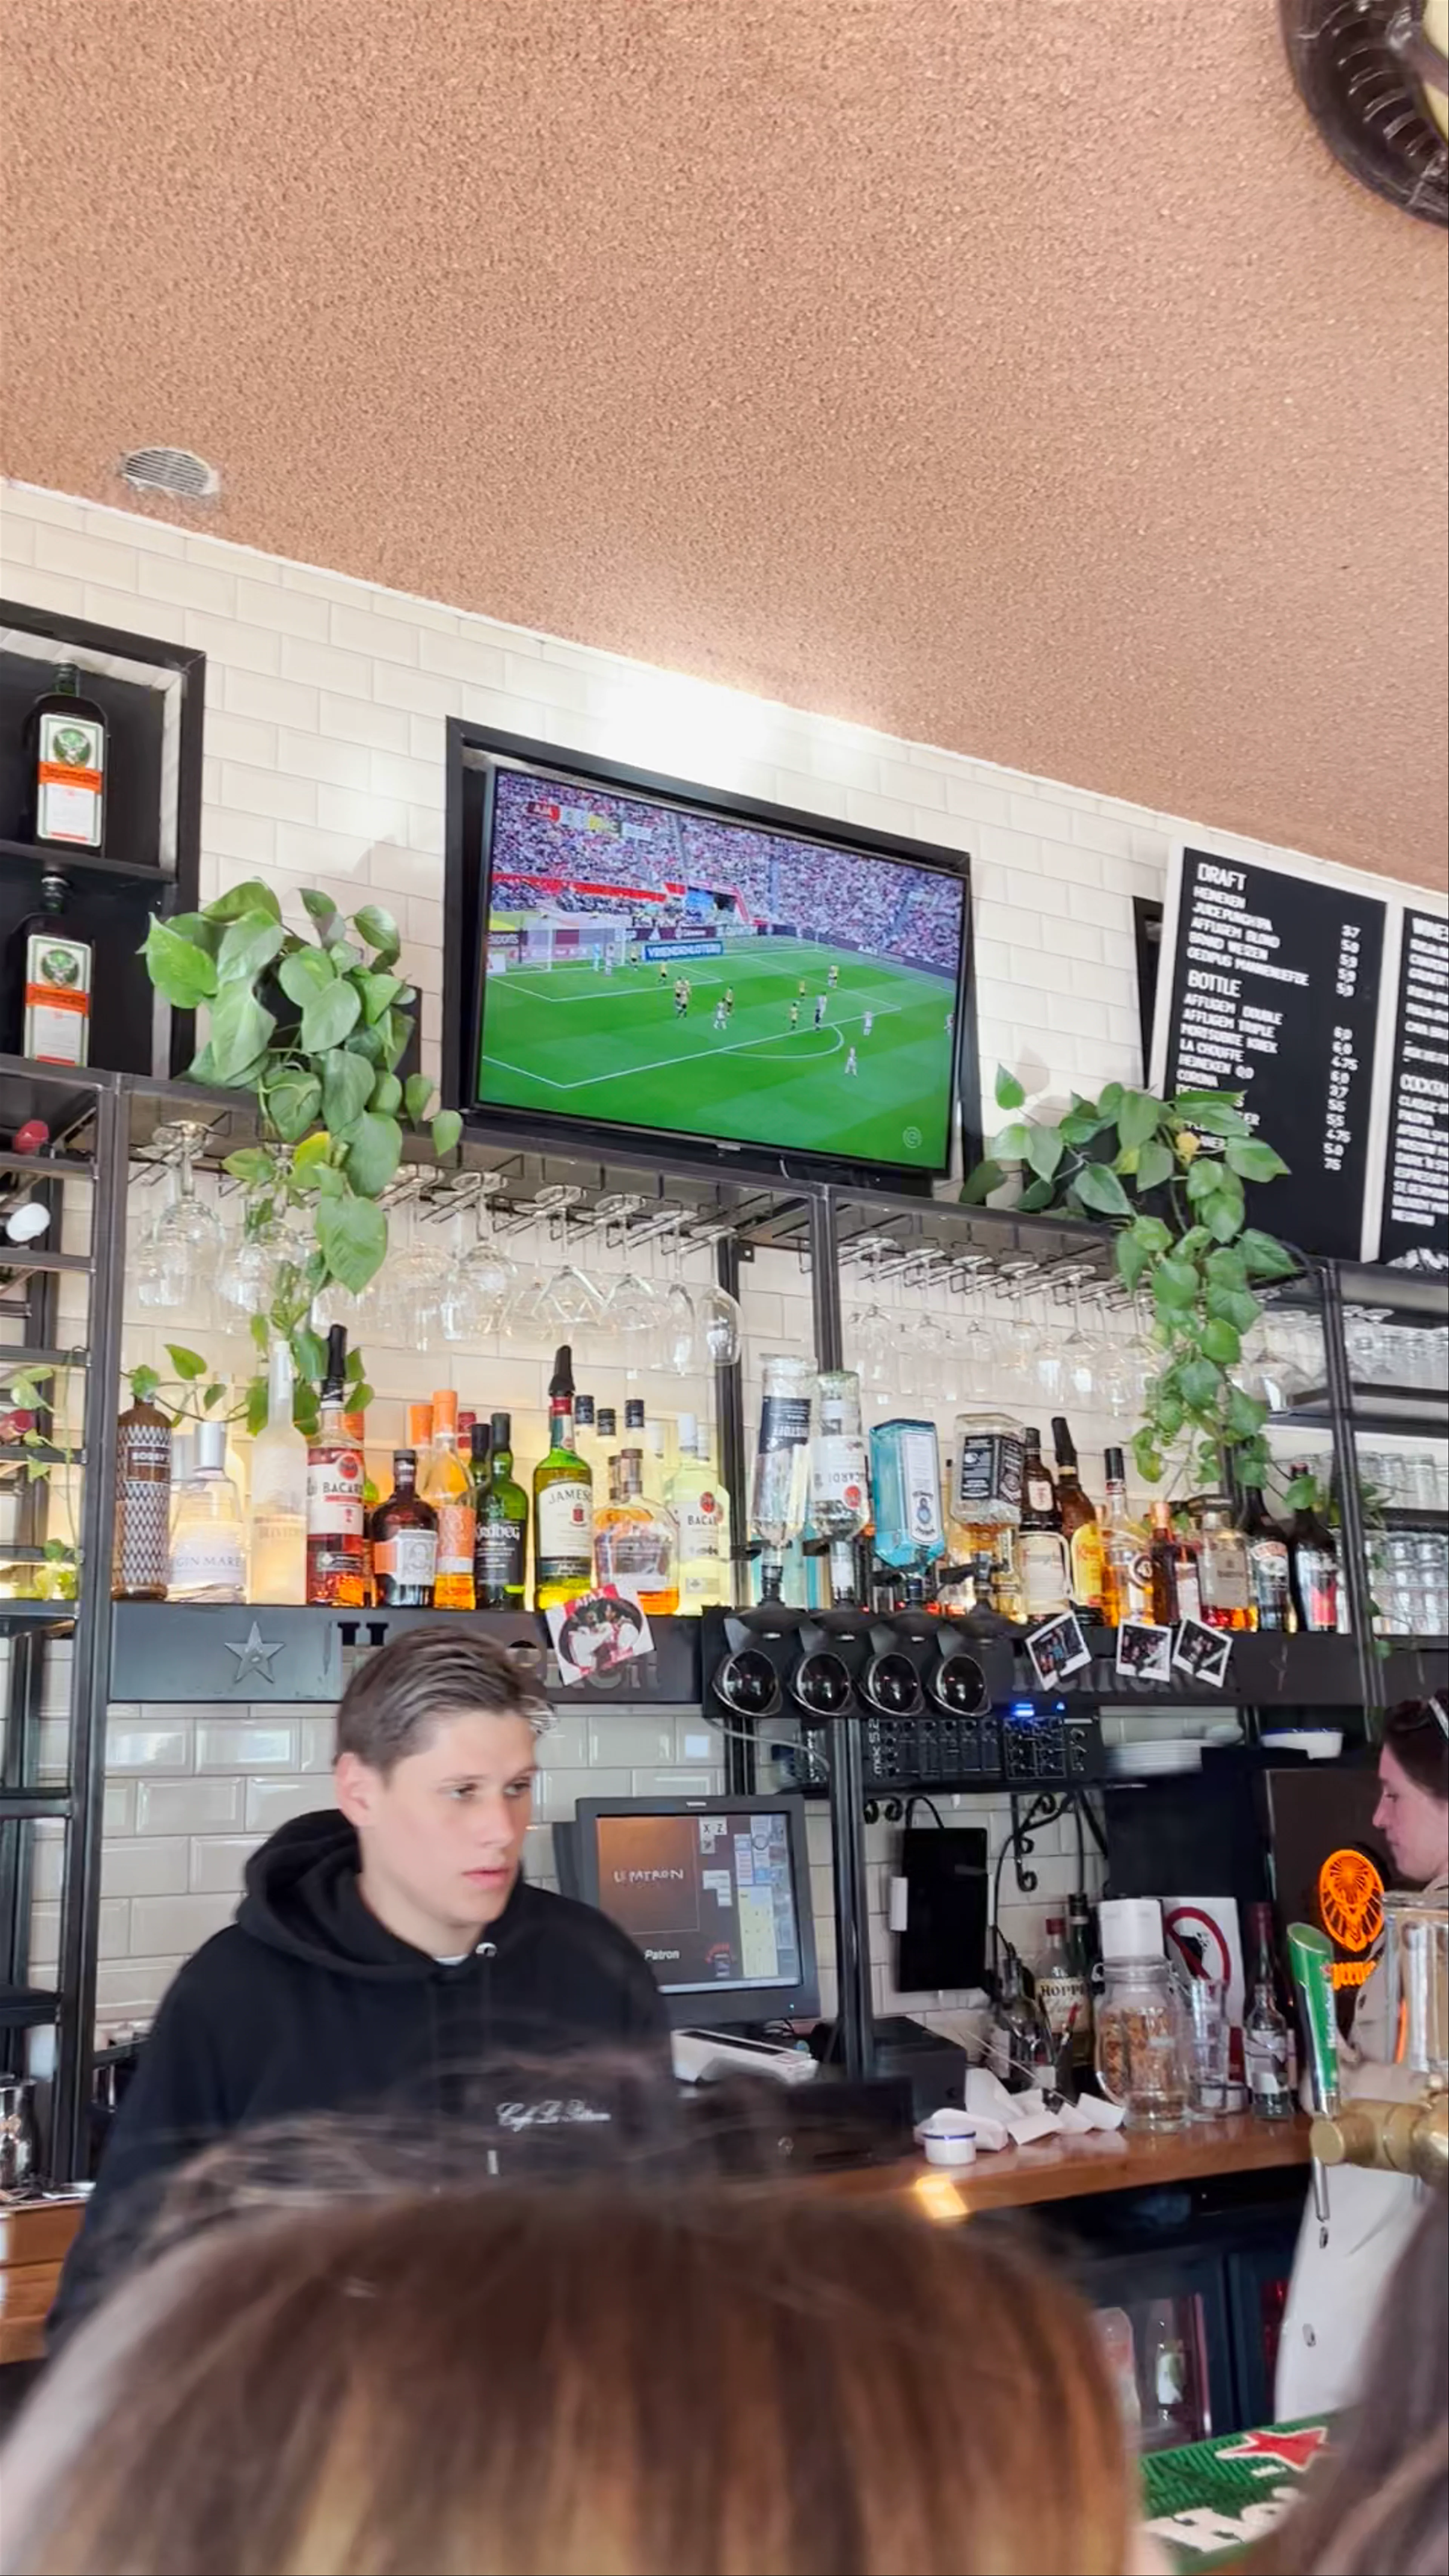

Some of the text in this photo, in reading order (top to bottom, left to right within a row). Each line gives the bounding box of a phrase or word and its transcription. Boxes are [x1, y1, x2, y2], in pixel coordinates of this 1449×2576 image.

[1197, 863, 1247, 891] DRAFT
[1188, 969, 1242, 998] BOTTLE
[1183, 993, 1236, 1014] AFFLIGEM
[1182, 1008, 1235, 1029] AFFLIGEM
[1179, 1038, 1194, 1052] LA
[177, 1556, 242, 1567] GIN MARE
[704, 1824, 723, 1833] X Z
[628, 1869, 684, 1883] PATRON
[645, 1949, 680, 1961] Patron
